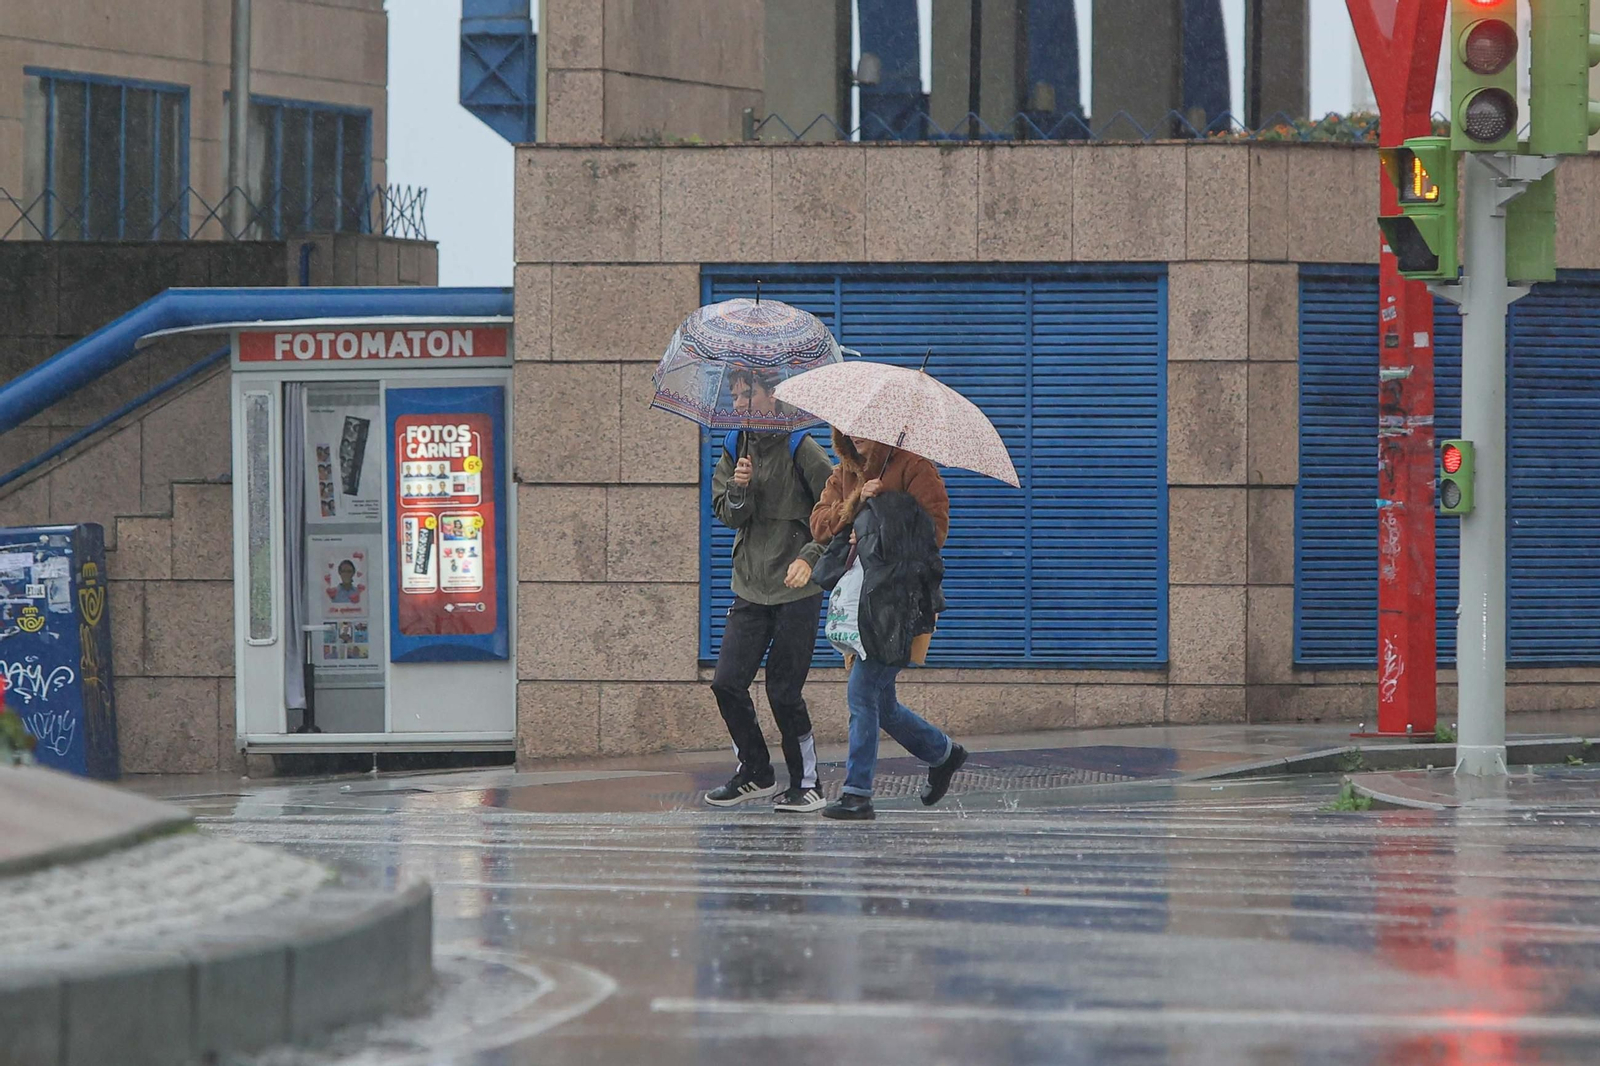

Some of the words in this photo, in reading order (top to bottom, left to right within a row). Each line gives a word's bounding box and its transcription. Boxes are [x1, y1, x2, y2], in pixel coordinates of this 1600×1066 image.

[274, 330, 474, 360] FOTOMATON
[406, 424, 472, 443] FOTOS
[406, 442, 472, 458] CARNET
